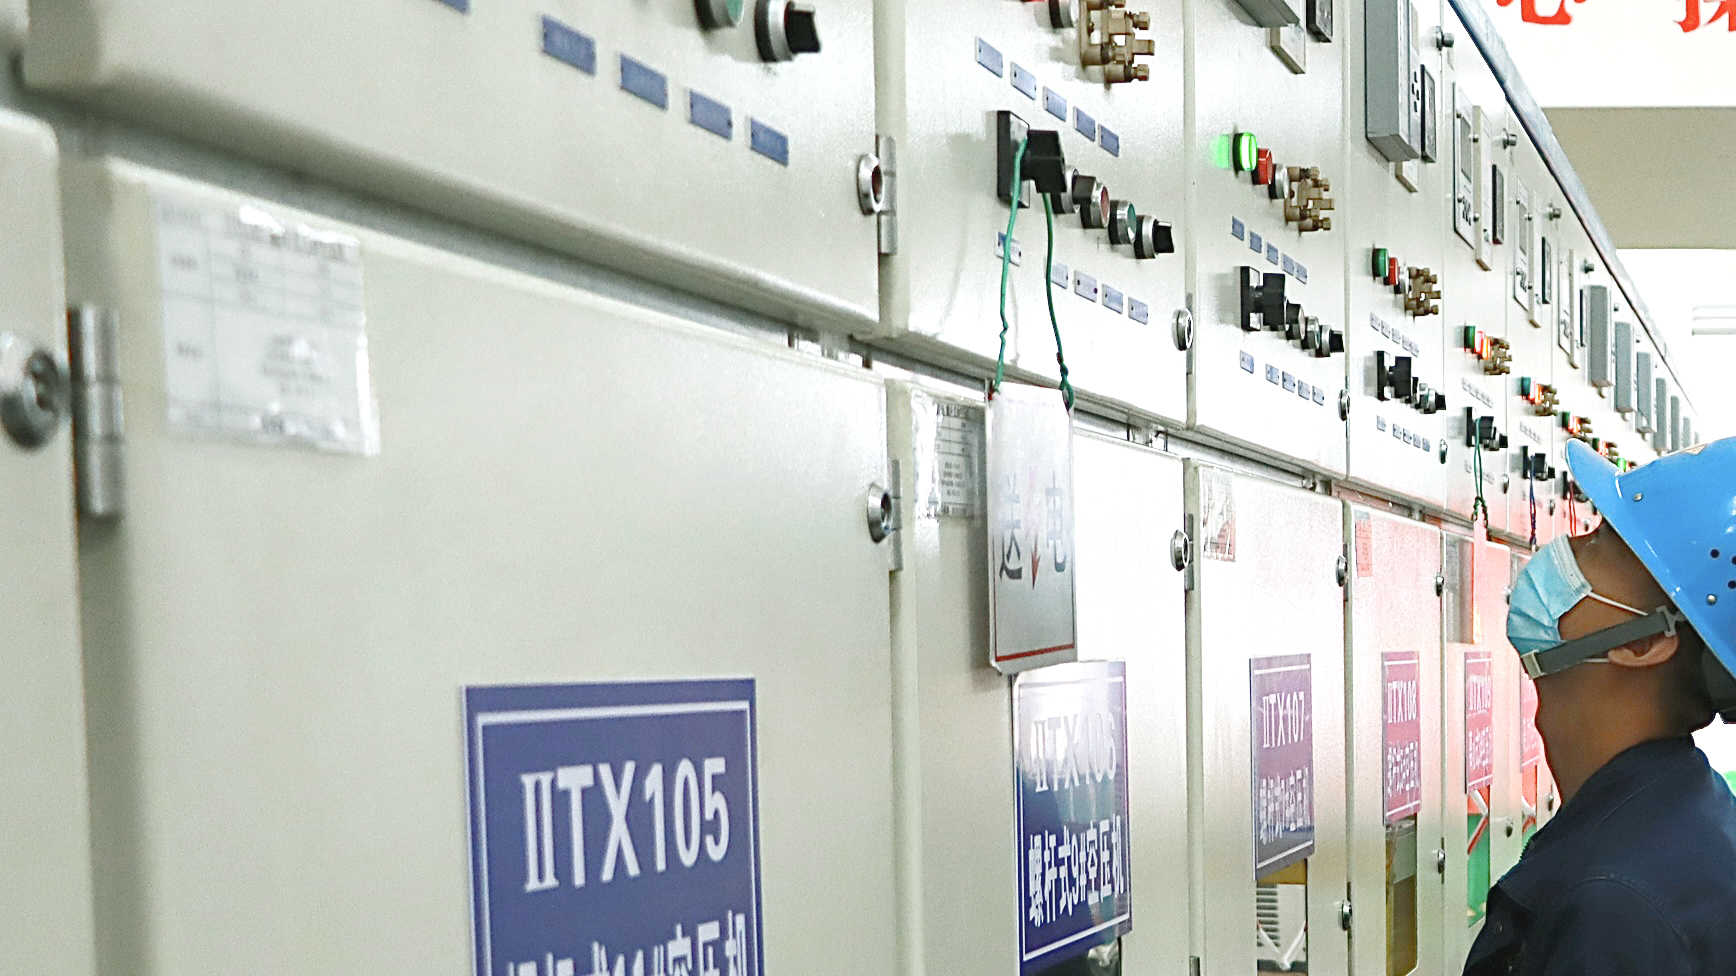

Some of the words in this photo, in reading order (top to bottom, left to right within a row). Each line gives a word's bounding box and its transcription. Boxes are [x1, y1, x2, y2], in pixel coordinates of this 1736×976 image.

[520, 756, 731, 893] ⅡTX105
[1028, 812, 1125, 929] 螺杆式9#空压机
